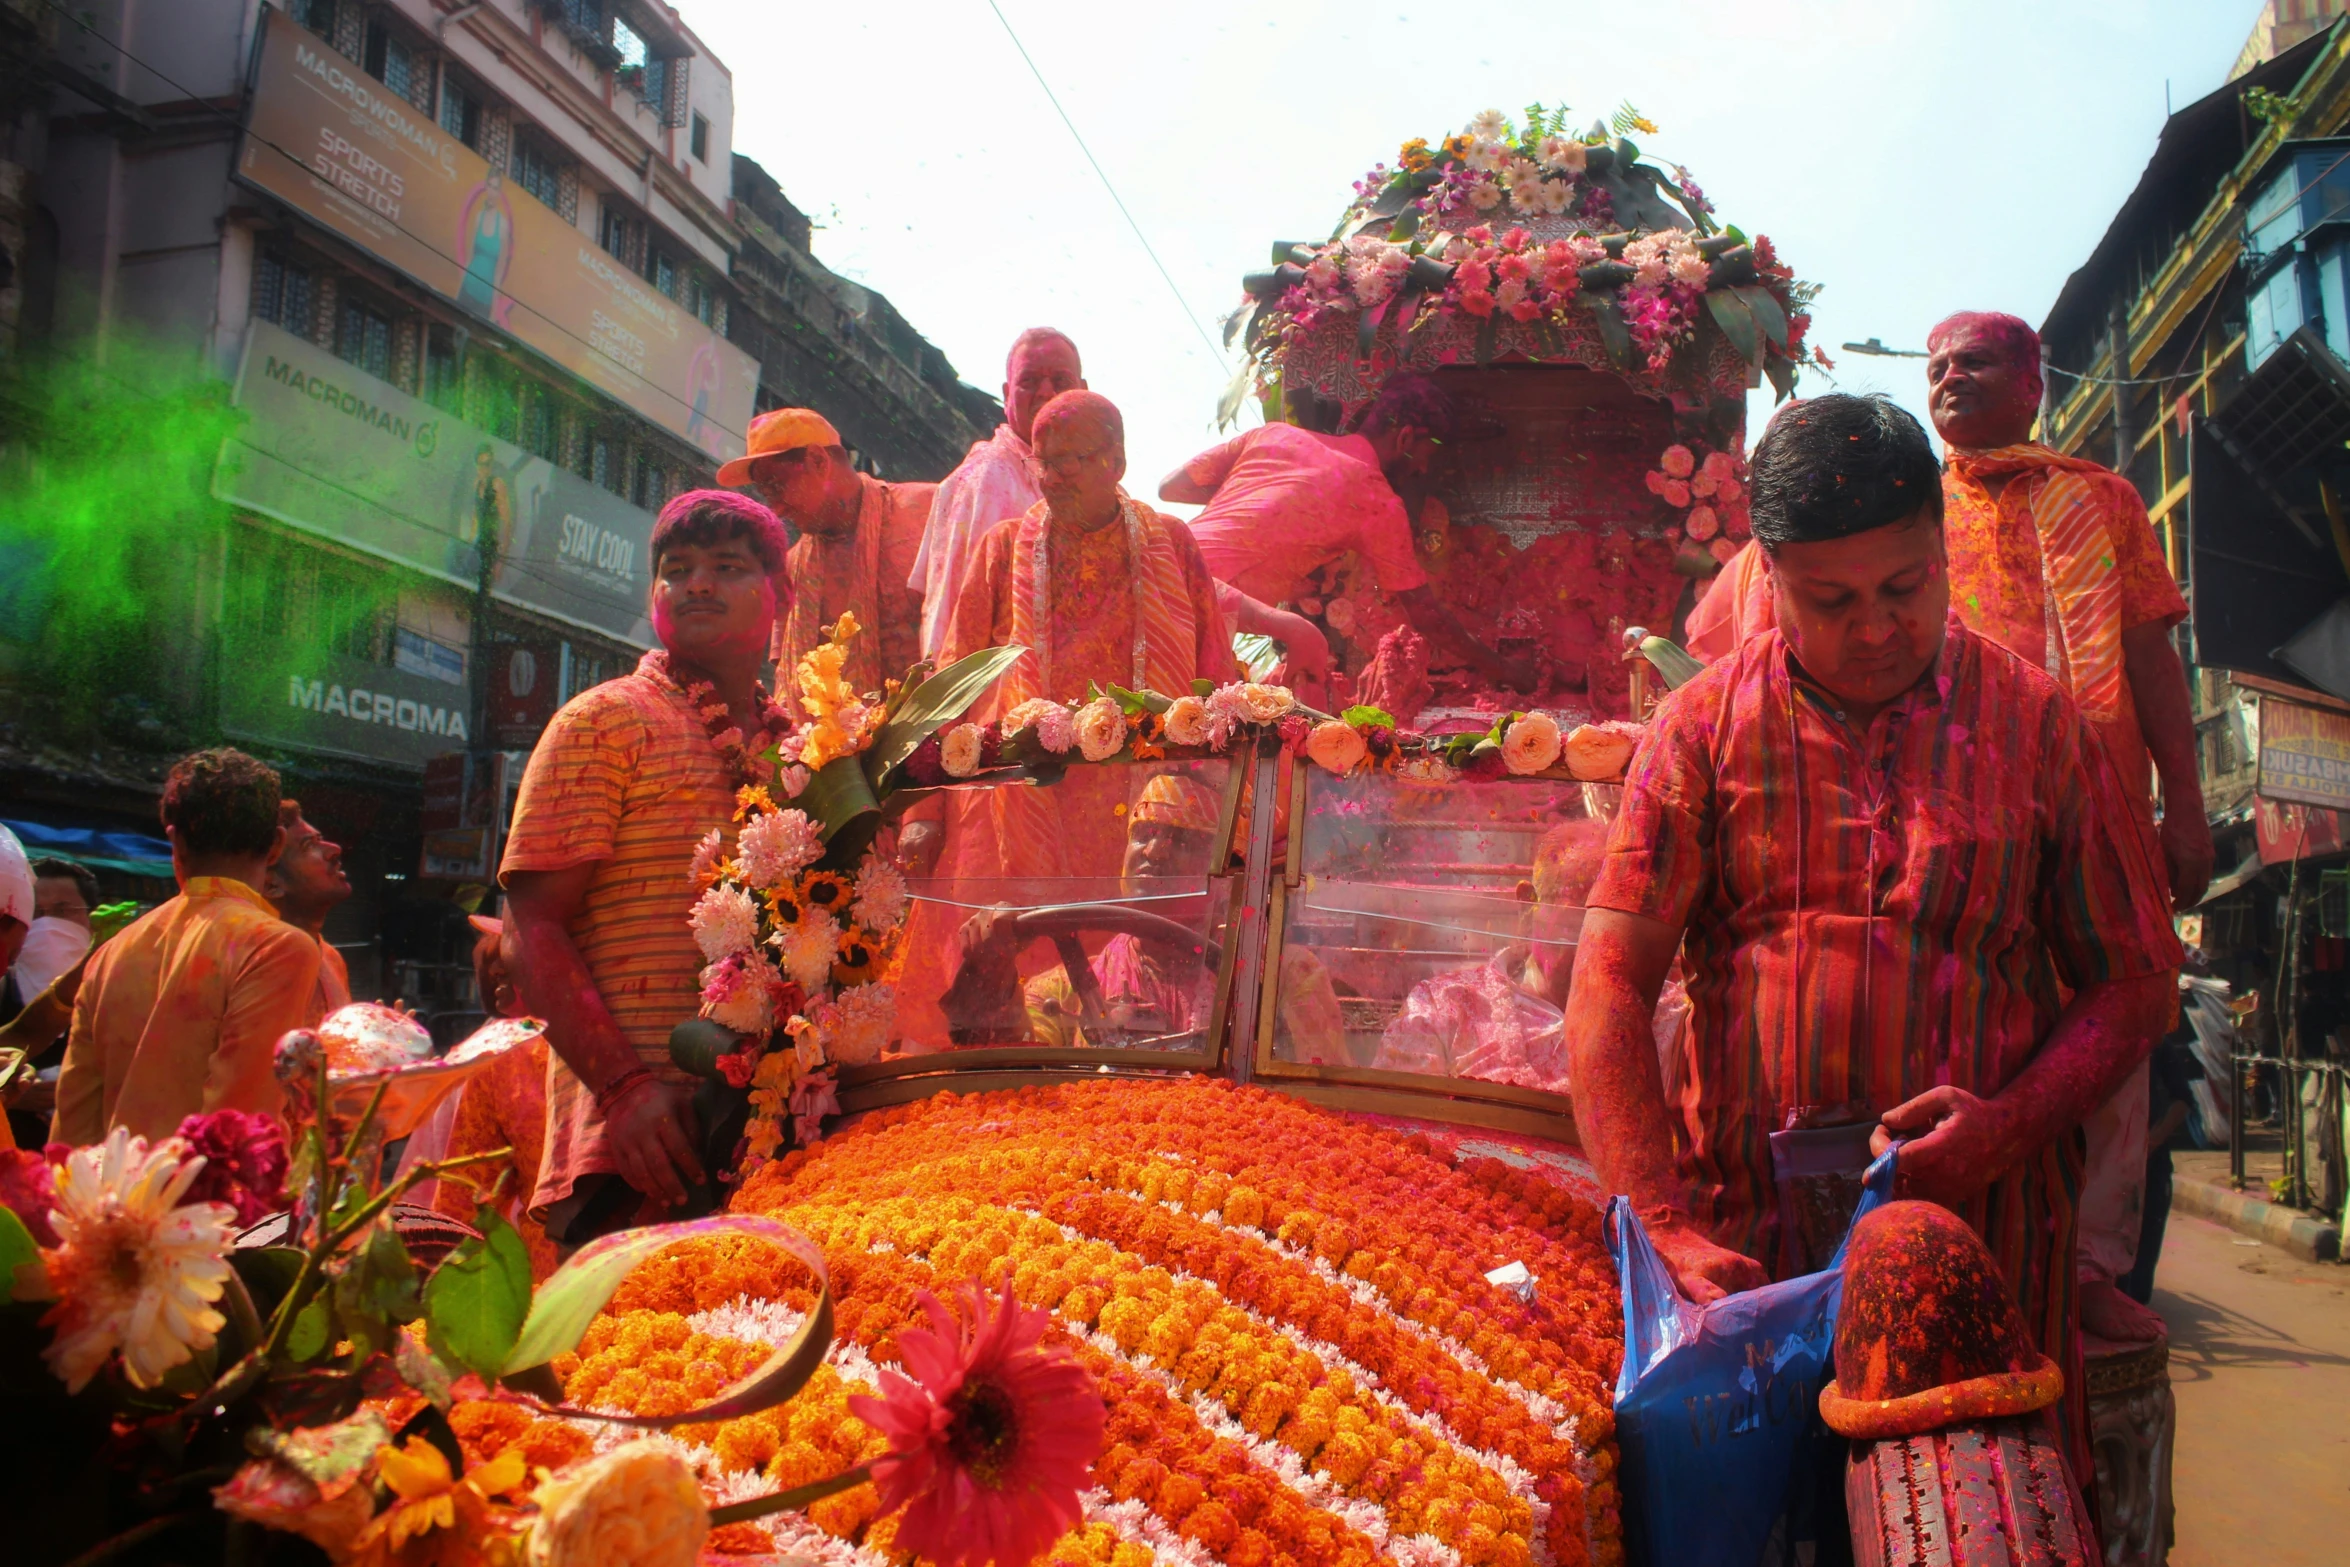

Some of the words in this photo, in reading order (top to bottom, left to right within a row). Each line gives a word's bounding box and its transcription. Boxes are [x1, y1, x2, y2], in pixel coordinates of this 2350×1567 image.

[295, 43, 440, 157] MACROWOMAN
[313, 153, 401, 220] STRETCH
[318, 127, 406, 198] SPORTS
[591, 308, 645, 357] SPORTS
[265, 355, 411, 440] MACROMAN
[559, 513, 600, 562] STAY
[598, 530, 635, 581] COOL
